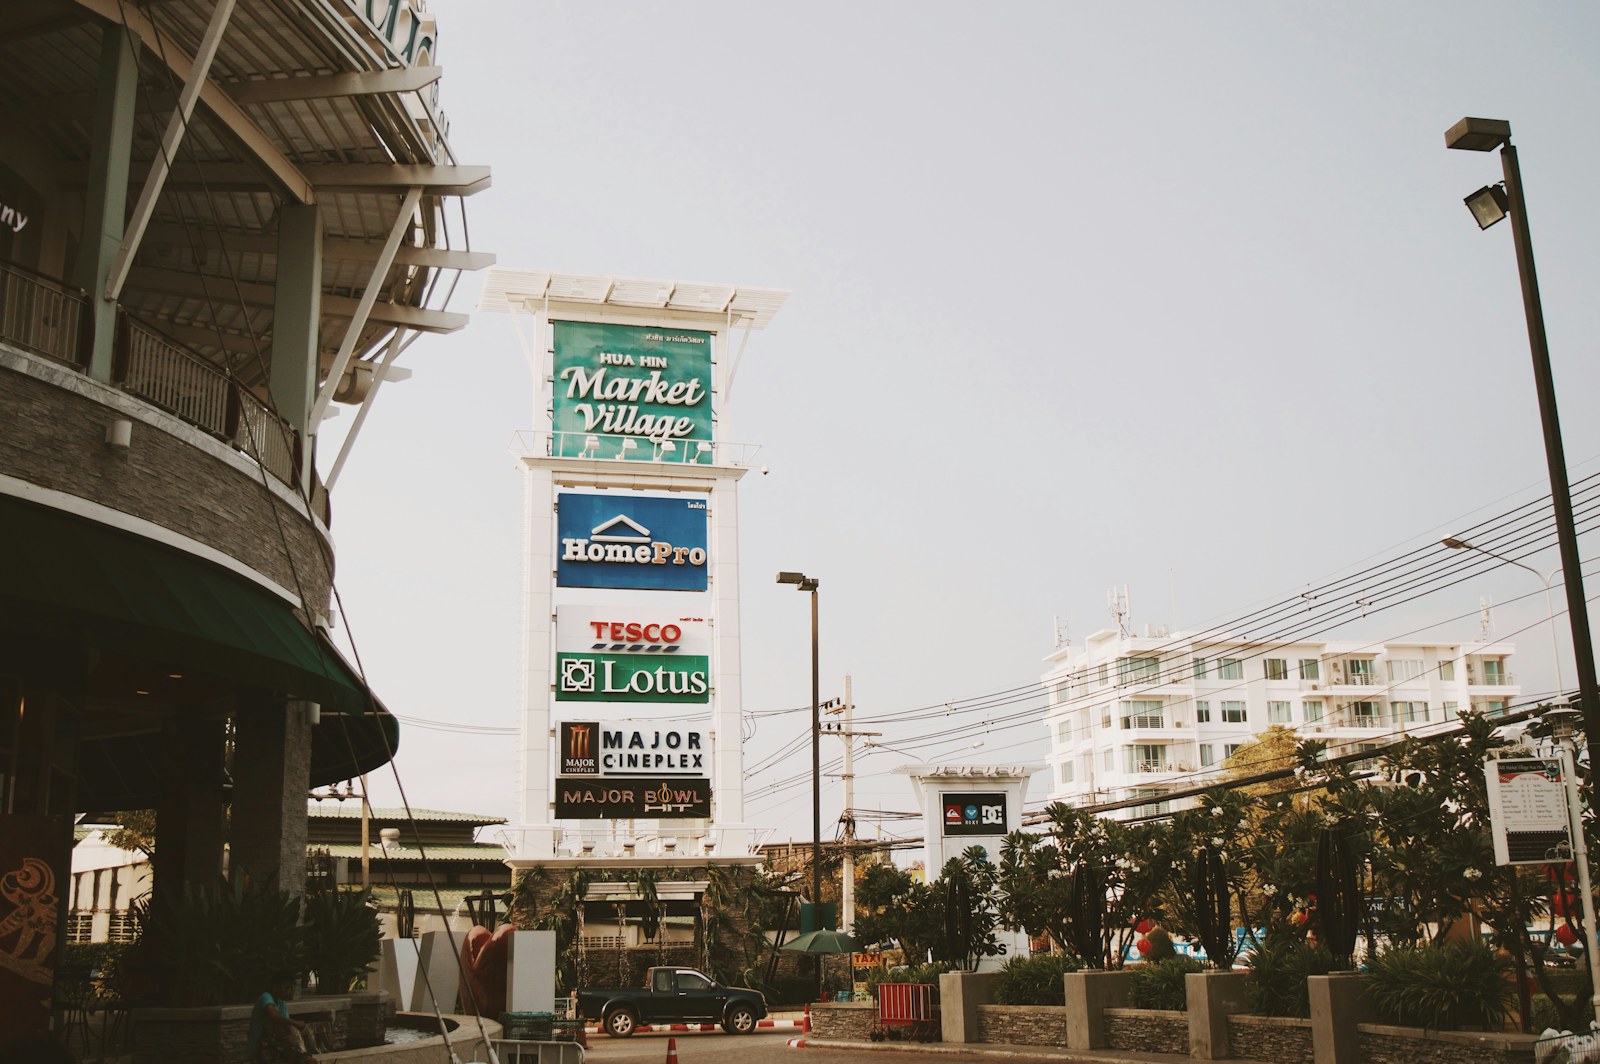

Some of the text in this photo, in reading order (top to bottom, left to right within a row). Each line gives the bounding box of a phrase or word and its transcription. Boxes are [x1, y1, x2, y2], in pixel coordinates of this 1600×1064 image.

[0, 202, 28, 232] ny
[600, 353, 668, 369] HUA HIN
[561, 366, 706, 406] Market
[575, 403, 695, 444] Village
[562, 538, 706, 566] HomePro
[590, 621, 682, 643] TESCO
[601, 660, 707, 694] Lotus
[603, 731, 702, 749] MAJOR
[565, 758, 595, 769] MAJOR
[603, 753, 703, 769] CINEPLEX
[563, 789, 635, 804] MAJOR
[854, 953, 881, 963] TAXI
